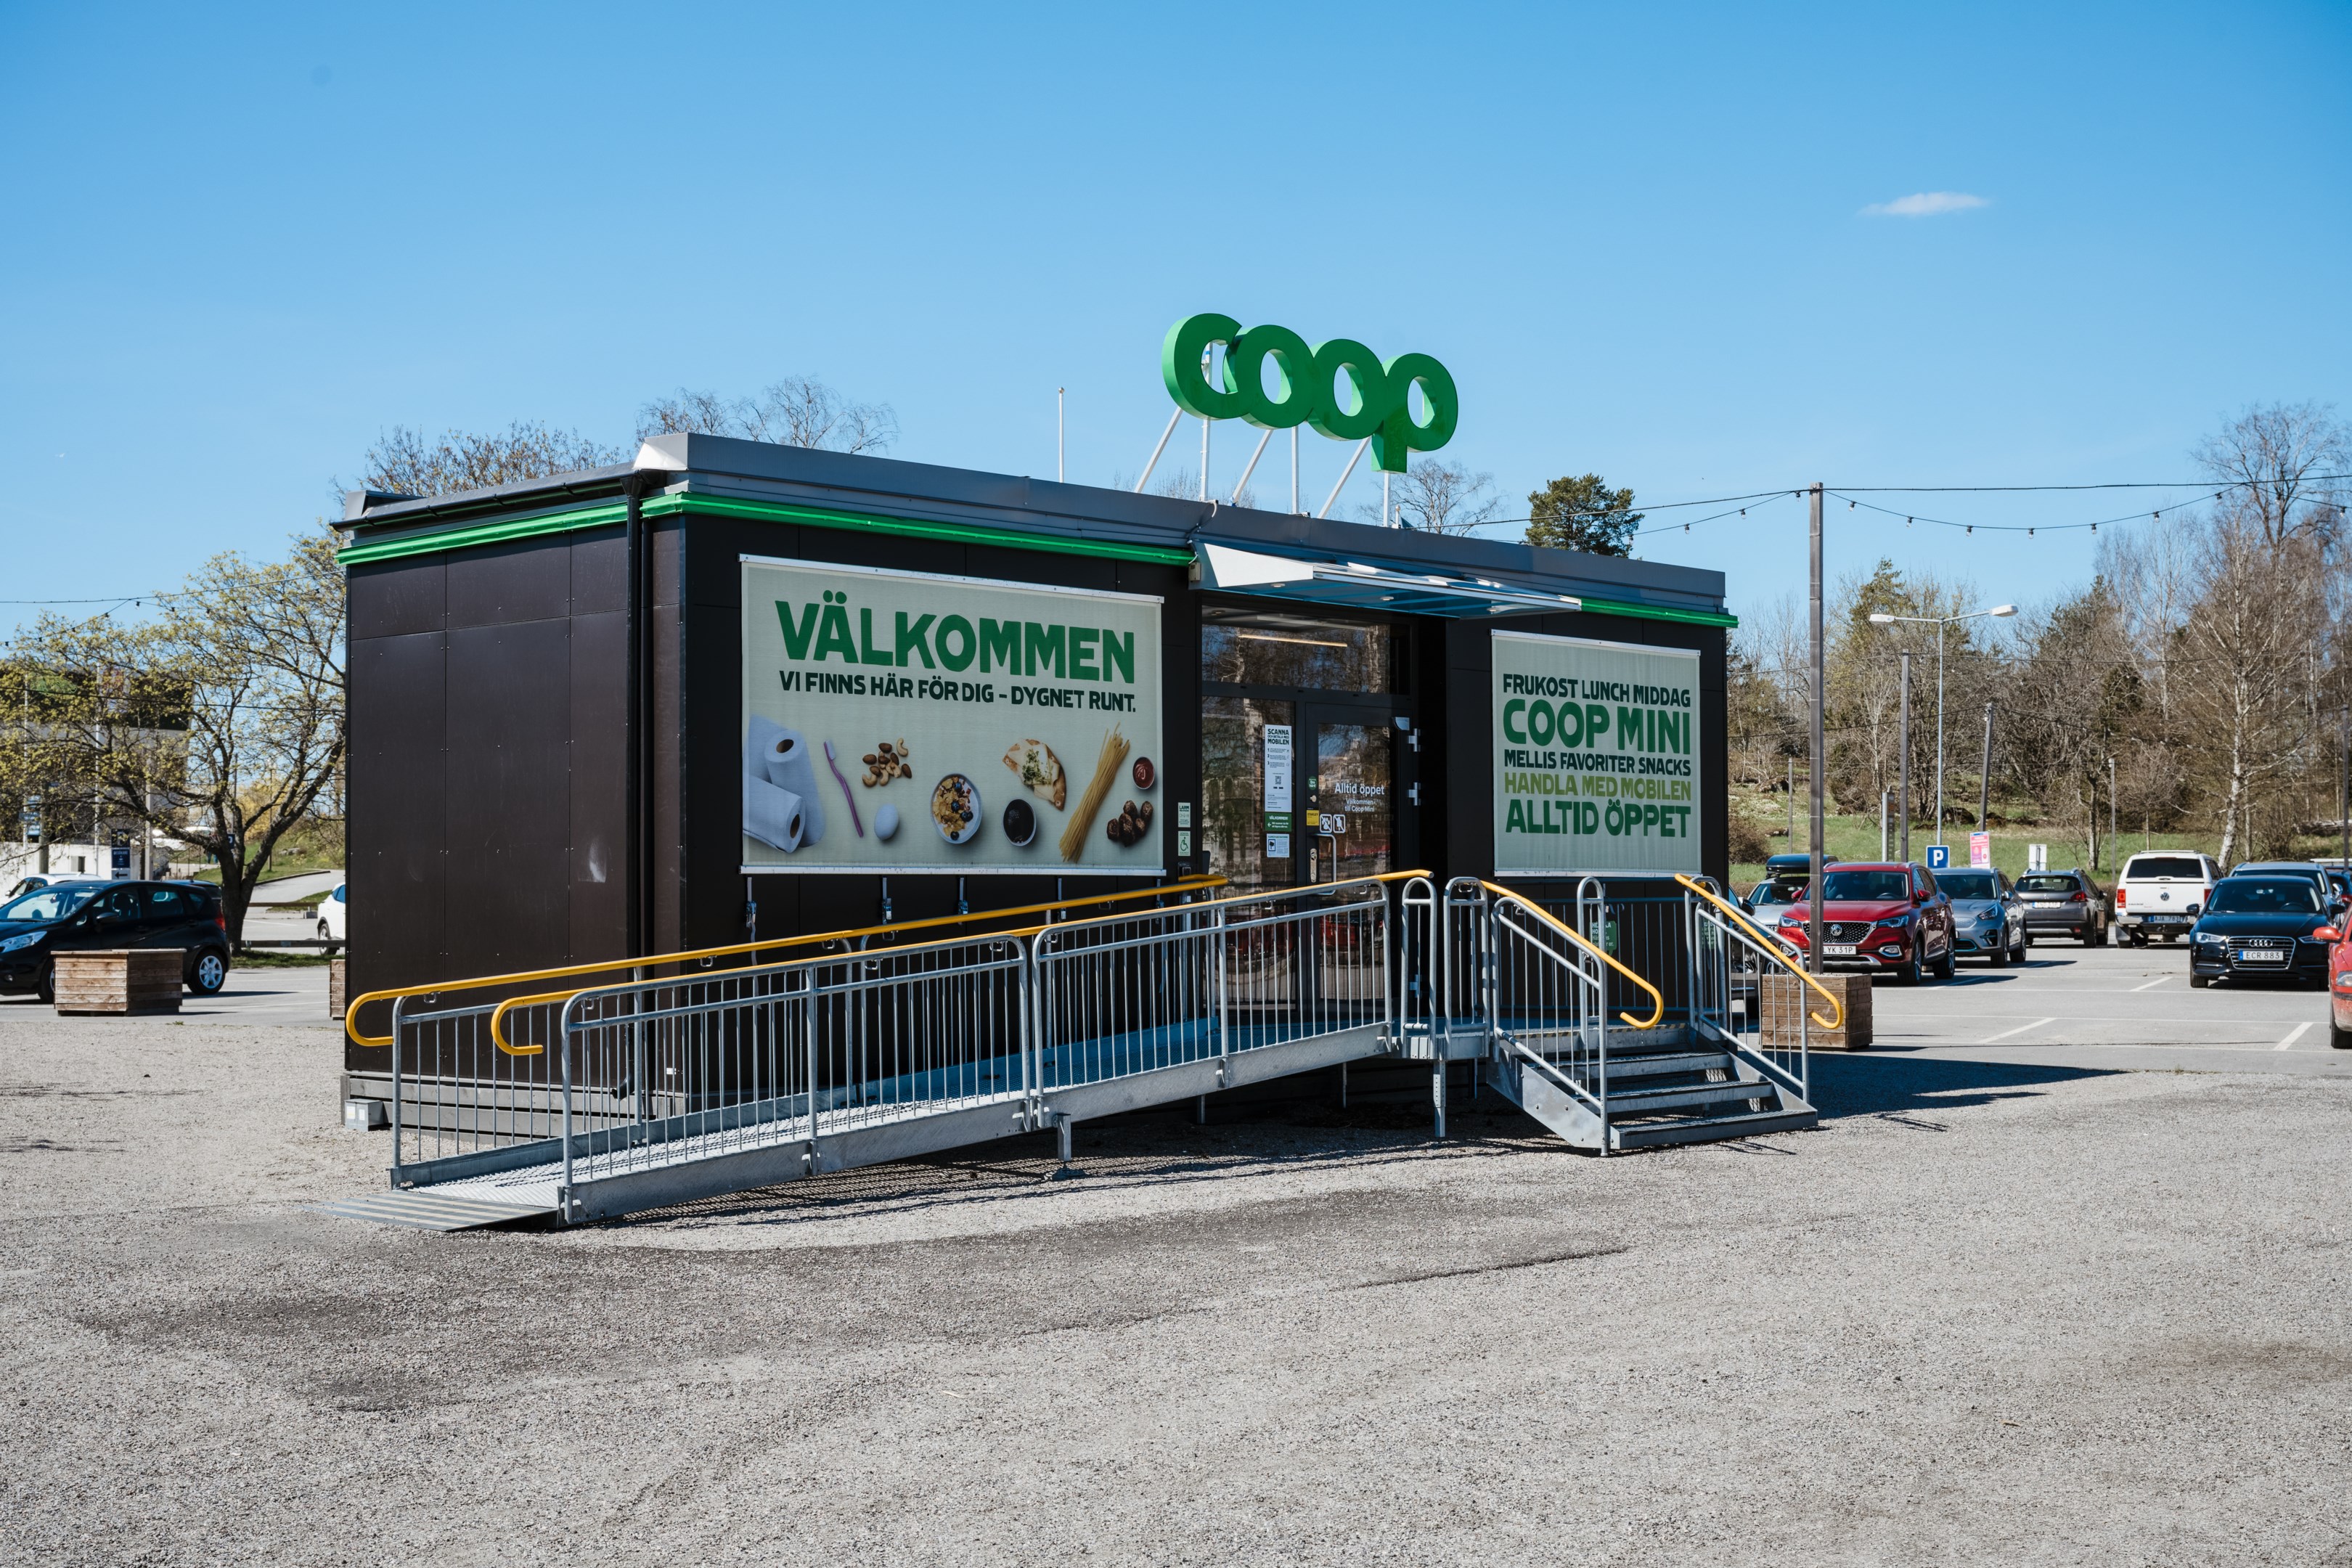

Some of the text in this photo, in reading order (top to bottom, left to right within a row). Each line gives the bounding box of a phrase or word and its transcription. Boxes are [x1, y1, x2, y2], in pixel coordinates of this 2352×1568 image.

[775, 590, 1135, 684] VÄLKOMMEN
[779, 670, 800, 692] VI
[805, 671, 866, 695] FINNS
[871, 673, 913, 698] HÄR
[918, 675, 958, 701] FÖR
[962, 682, 995, 703] DIG
[1011, 685, 1084, 709] DYGNET
[1089, 693, 1136, 712] RUNT.
[1503, 674, 1691, 707] FRUKOST LUNCH MIDDAG
[1503, 698, 1690, 754] COOP MINI
[1504, 749, 1691, 776] MELLIS FAVORITER SNACKS
[1335, 783, 1384, 797] Alltid öppet
[1504, 772, 1691, 801] HANDLA MED MOBILEN
[1506, 799, 1691, 838] ALLTID ÖPPET
[1933, 849, 1943, 866] P
